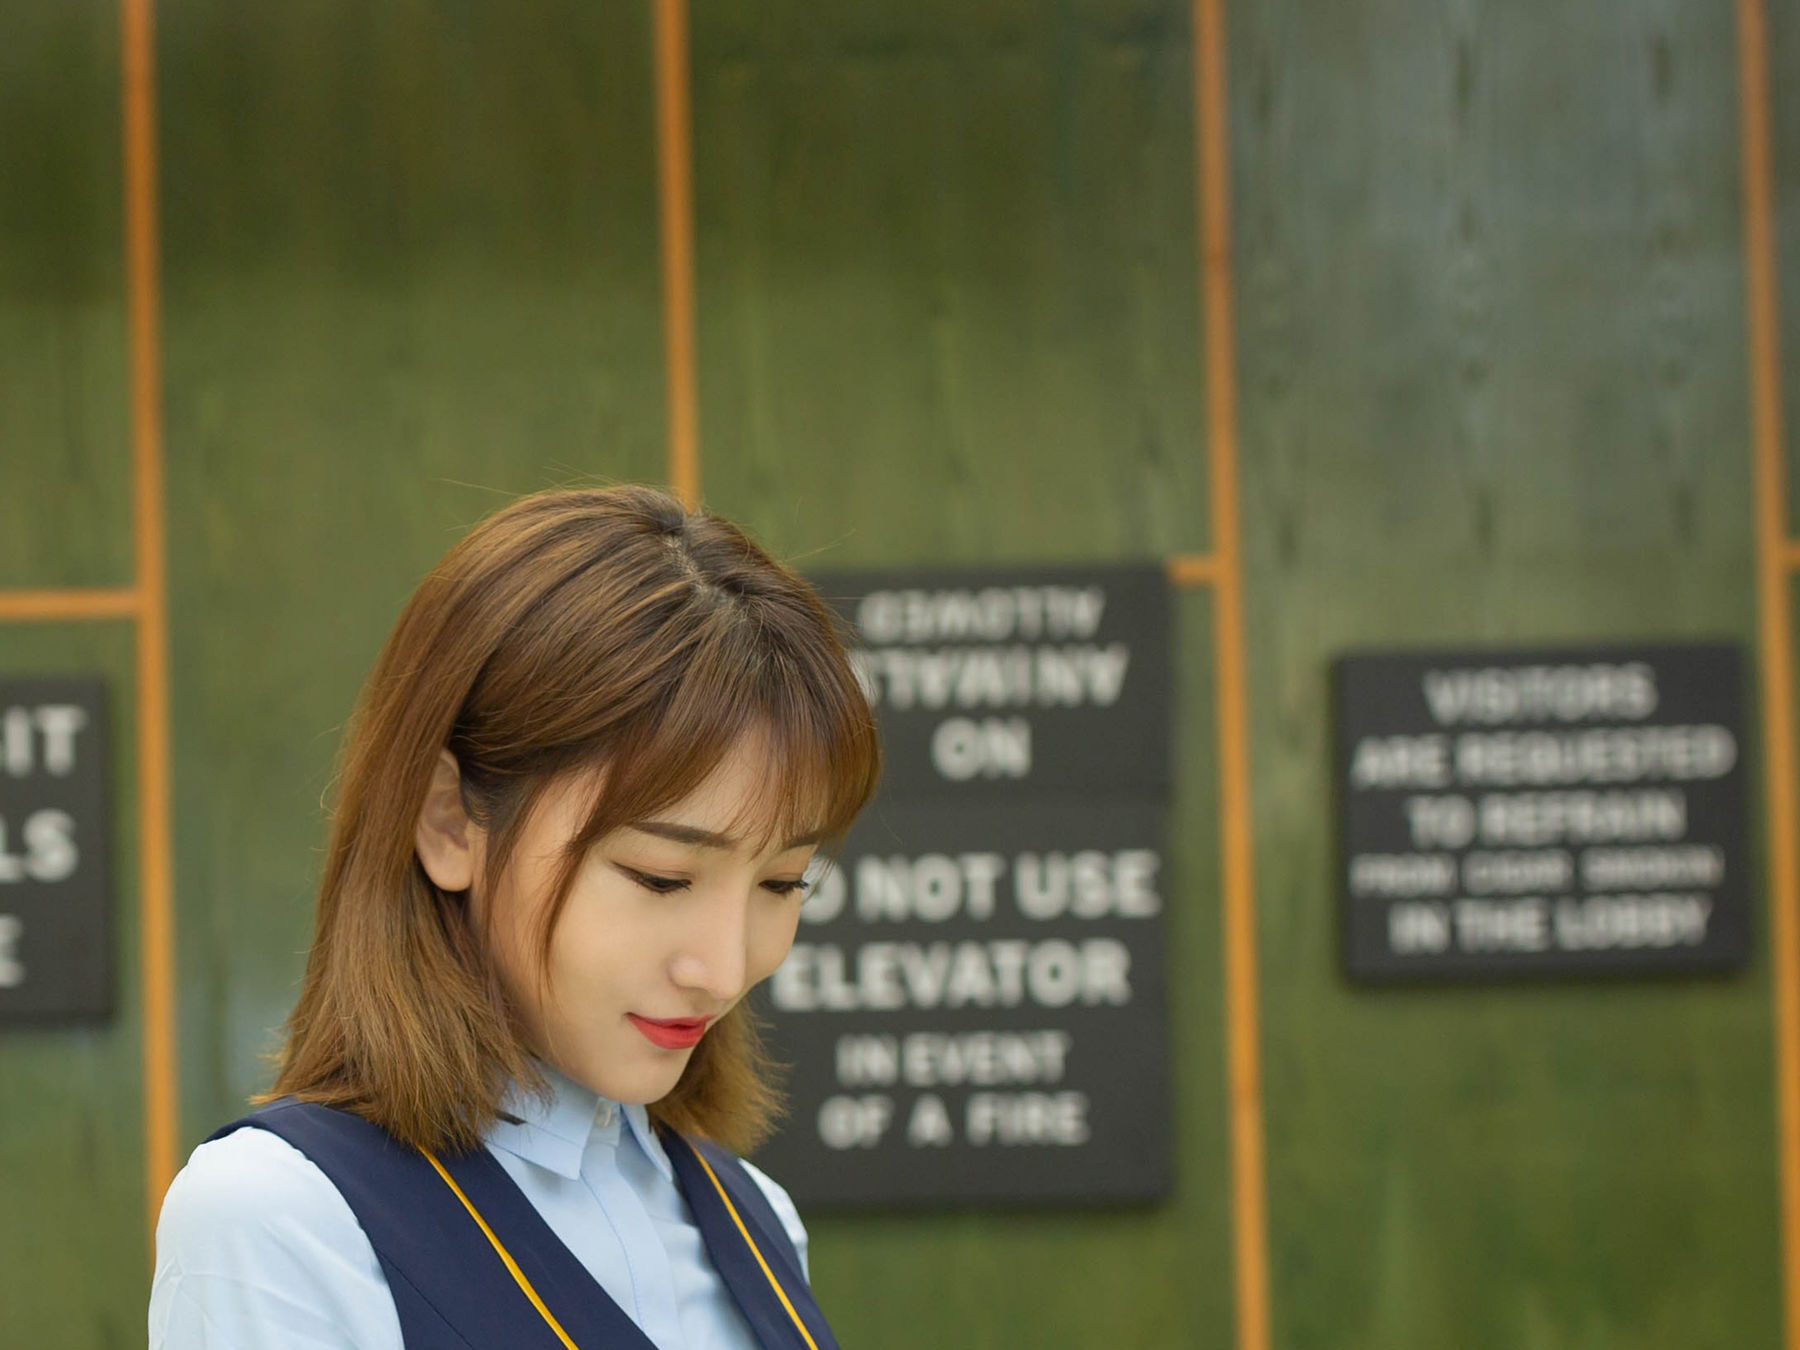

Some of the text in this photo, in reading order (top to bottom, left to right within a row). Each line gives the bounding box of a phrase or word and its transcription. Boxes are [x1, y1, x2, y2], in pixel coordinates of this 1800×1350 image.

[1425, 665, 1657, 724] VISITORS
[0, 704, 86, 777] IT
[931, 718, 1031, 780] NO
[1352, 726, 1736, 788] ARE REQUESTED
[1409, 790, 1686, 848] TO REFRAIN
[855, 853, 1005, 922] NOT
[1013, 850, 1160, 920] USE
[1351, 853, 1457, 895] FROM
[1388, 894, 1711, 953] IN THE LOBBY
[771, 938, 1132, 1012] ELEVATOR
[836, 1030, 1071, 1086] IN EVENT
[818, 1091, 1088, 1149] OF A FIRE
